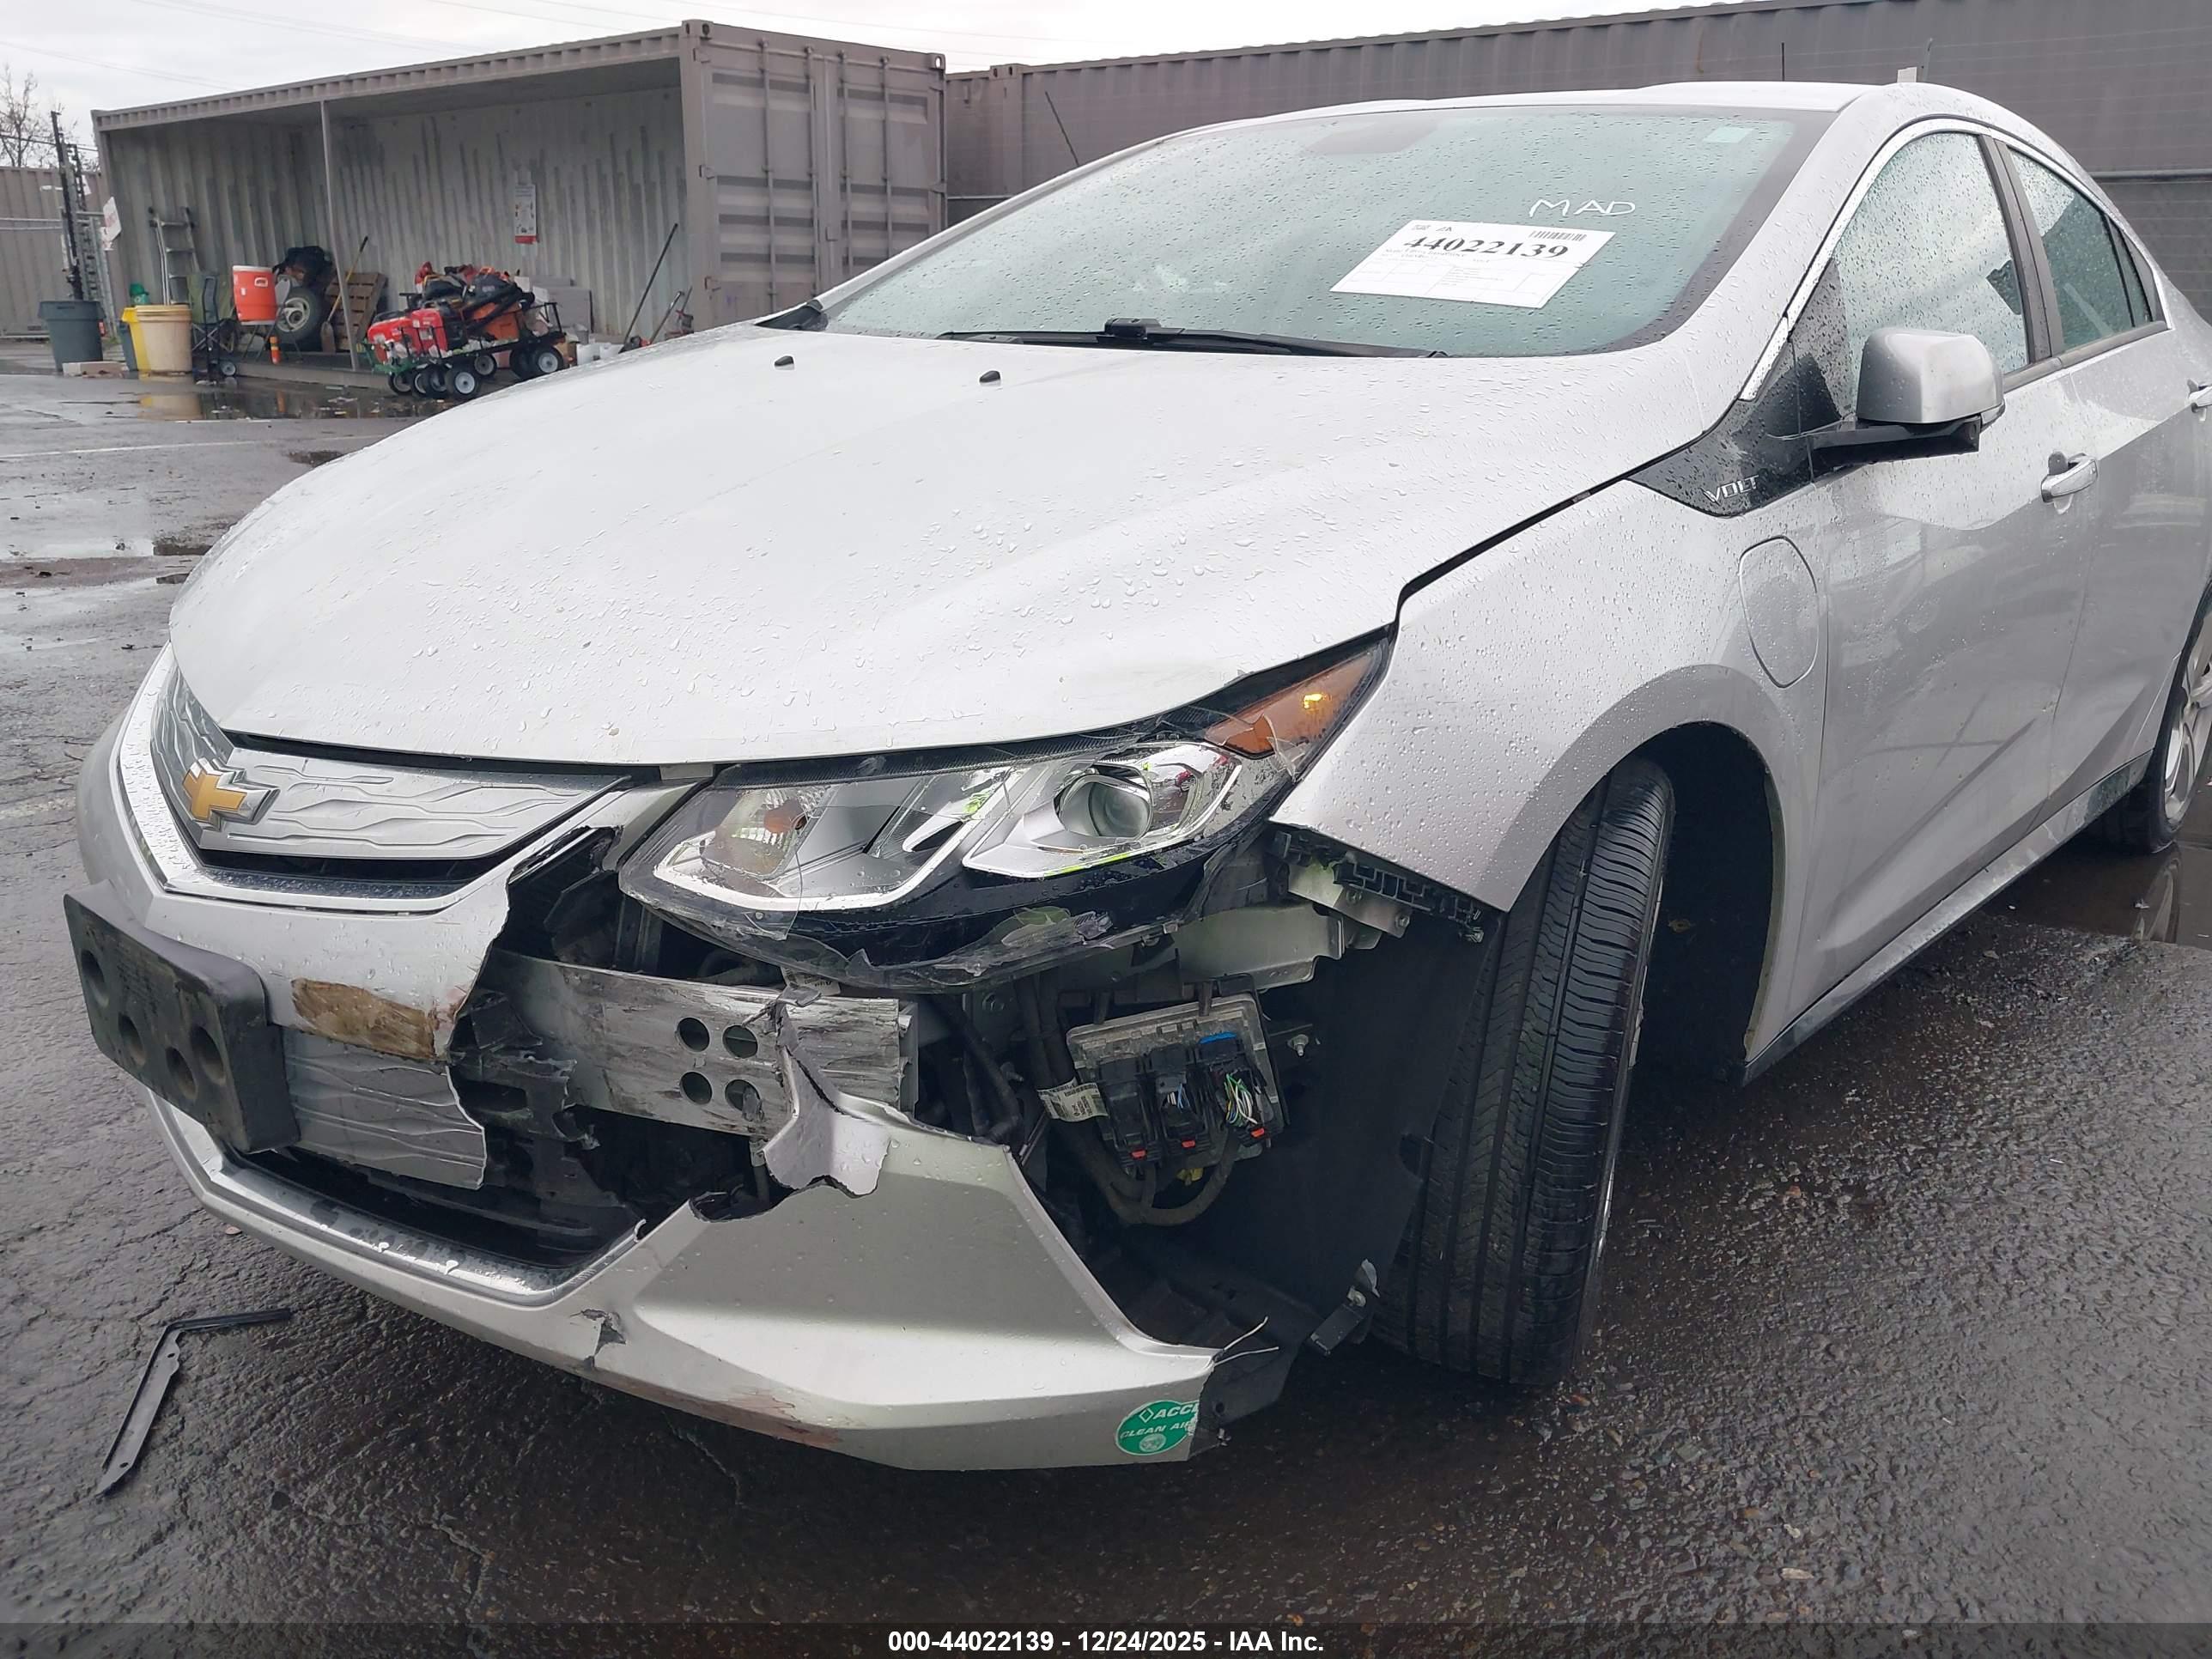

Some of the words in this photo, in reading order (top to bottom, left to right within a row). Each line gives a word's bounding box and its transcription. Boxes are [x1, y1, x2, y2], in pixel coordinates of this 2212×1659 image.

[1528, 198, 1636, 218] MAD
[1403, 236, 1568, 258] 44022139
[1701, 474, 1759, 504] VOLT
[1120, 1425, 1167, 1439] CLEAN
